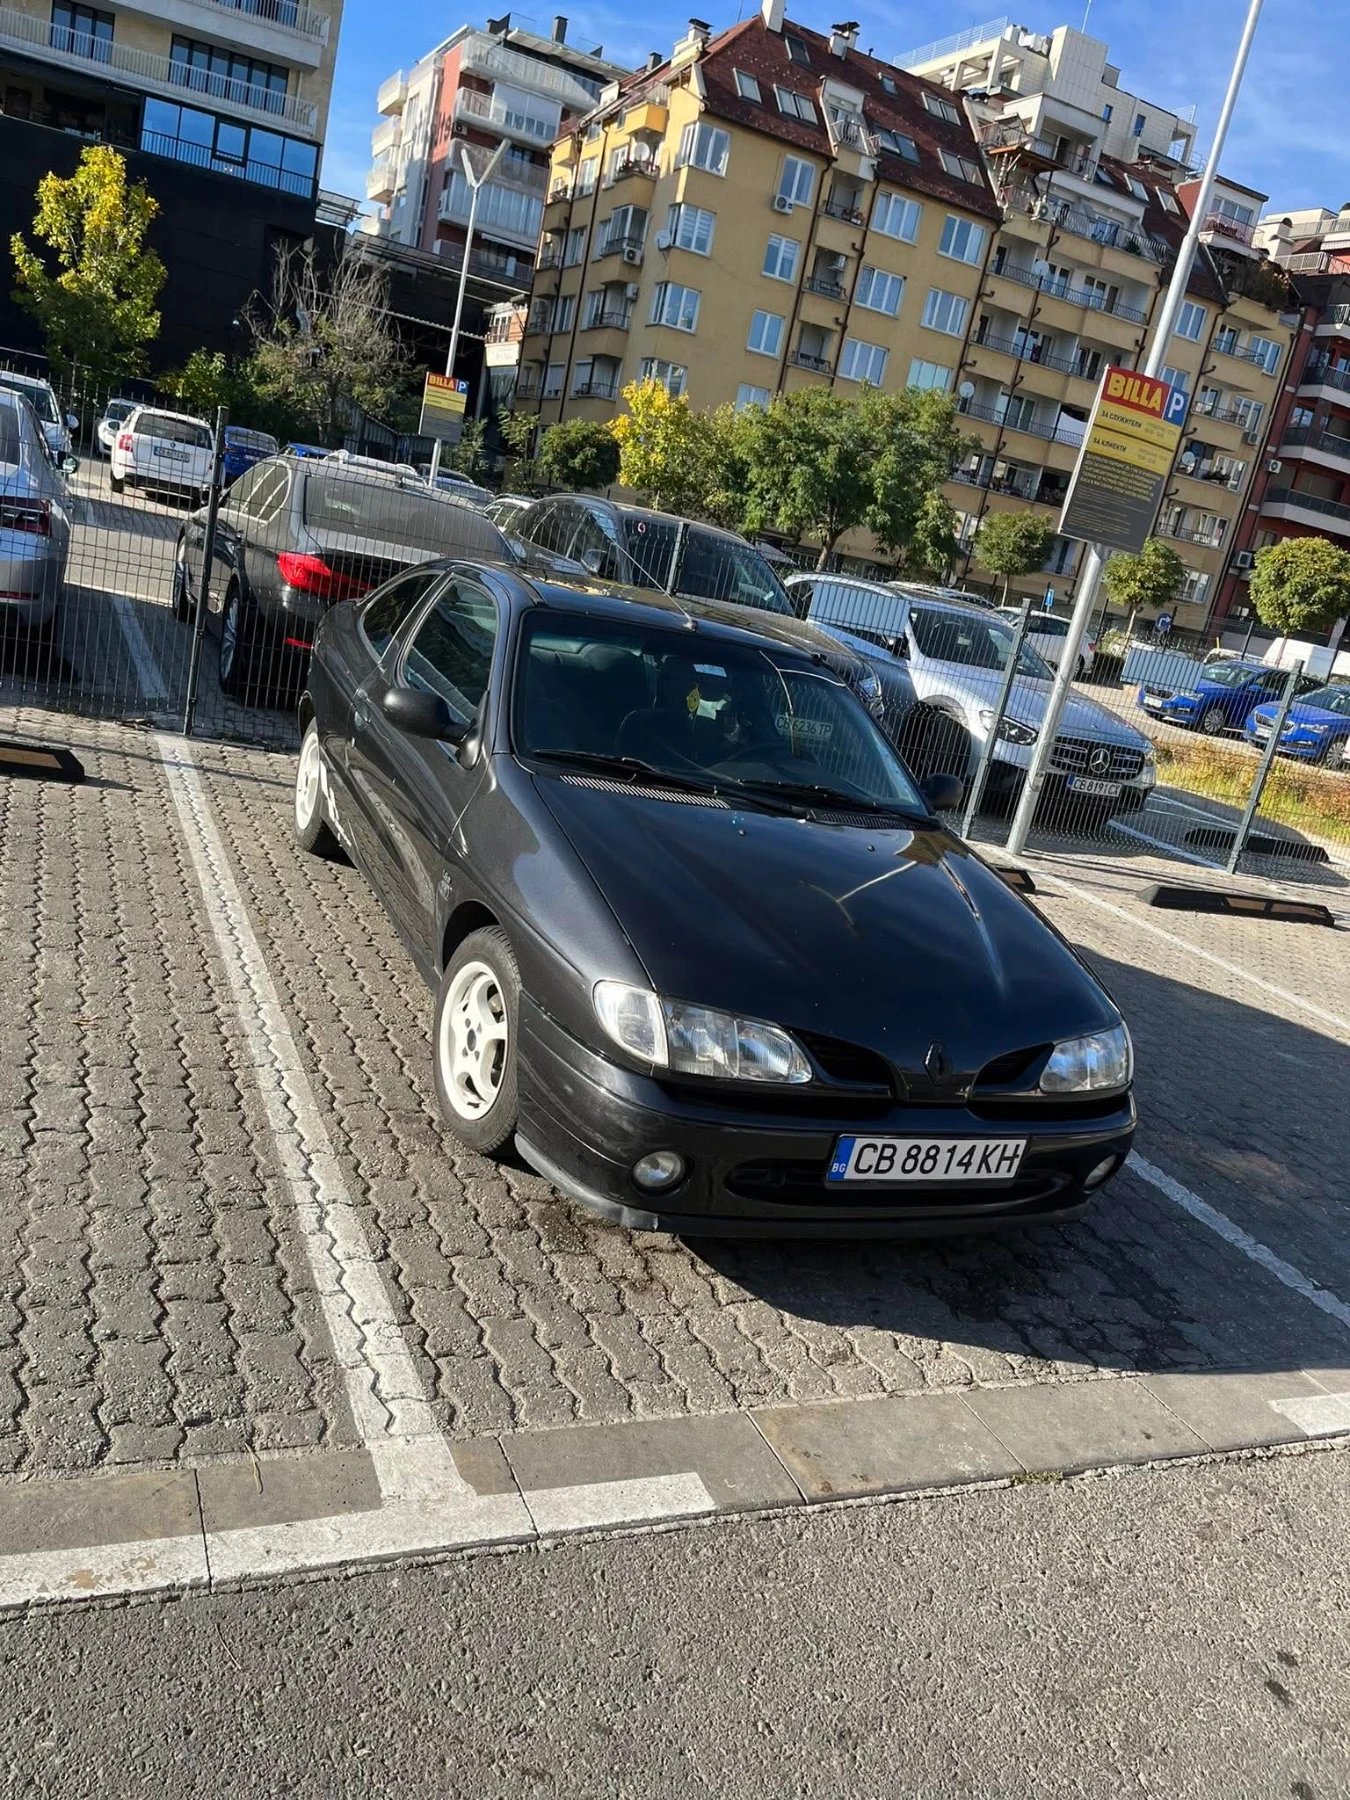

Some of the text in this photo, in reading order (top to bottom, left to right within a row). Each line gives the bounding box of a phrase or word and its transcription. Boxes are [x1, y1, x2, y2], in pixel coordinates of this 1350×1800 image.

[428, 375, 455, 389] BILLA
[458, 381, 467, 391] P
[1106, 372, 1163, 412] BILLA
[1167, 391, 1184, 419] P
[1101, 410, 1142, 428] ЗА СЛУЖИТЕЛИ
[1093, 437, 1127, 453] ЗА КЛИЕНТИ
[831, 1162, 847, 1173] BG
[853, 1143, 898, 1175] CB
[900, 1144, 977, 1175] 8814
